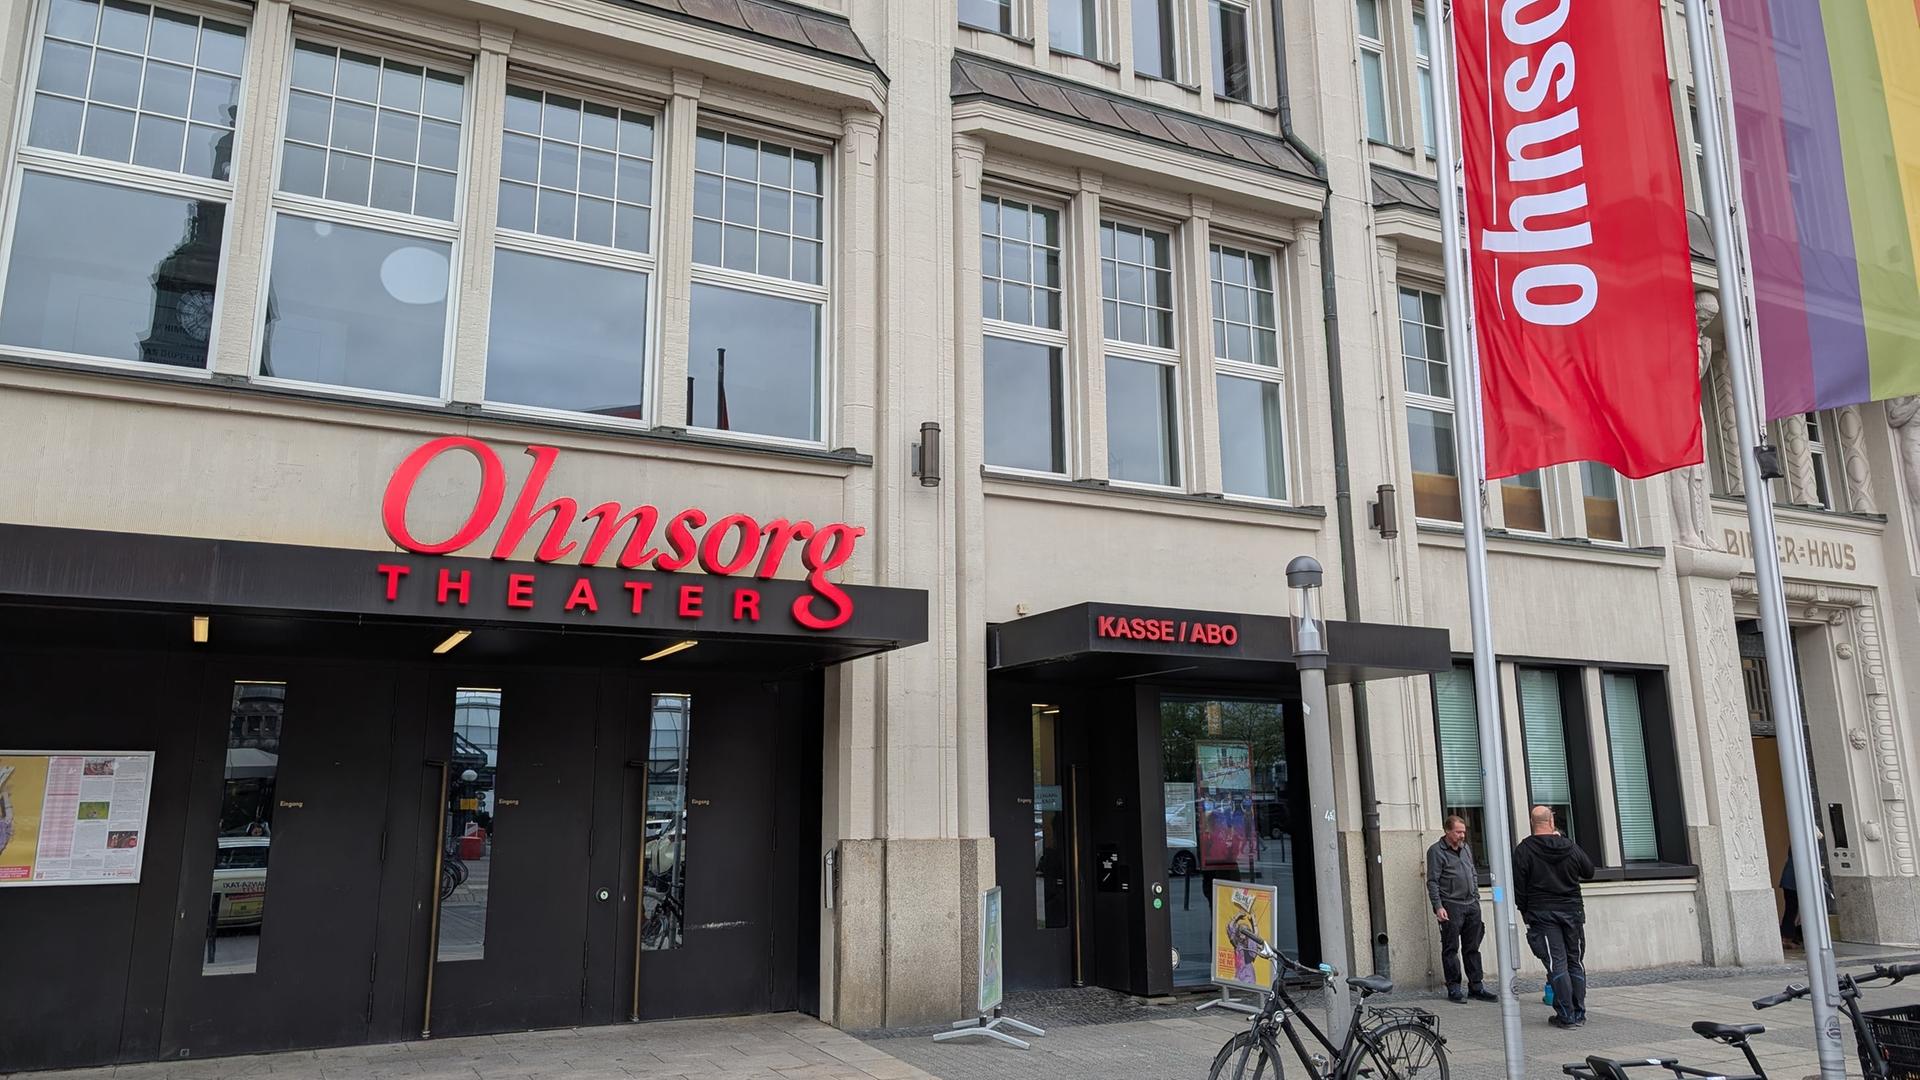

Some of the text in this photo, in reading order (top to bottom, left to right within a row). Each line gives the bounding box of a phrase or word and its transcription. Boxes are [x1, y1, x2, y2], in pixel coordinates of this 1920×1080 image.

[381, 435, 866, 631] Ohnsorg
[377, 564, 761, 622] THEATER
[1097, 615, 1175, 642] KASSE
[1189, 622, 1239, 647] ABO
